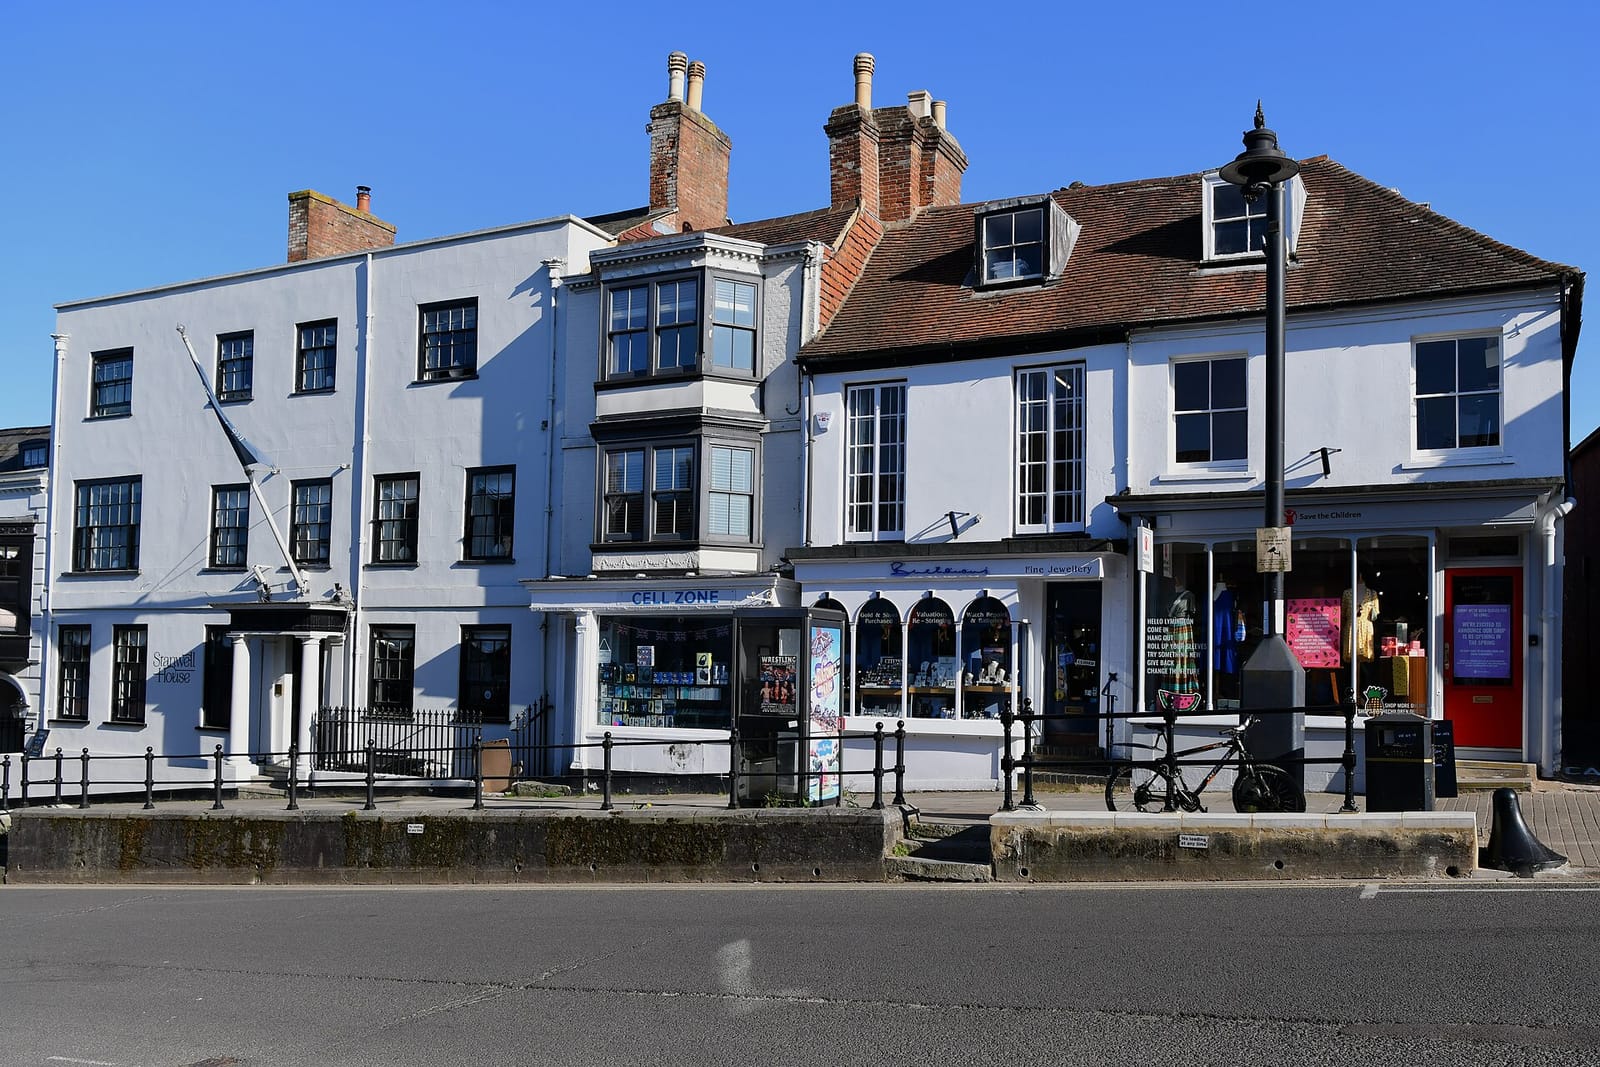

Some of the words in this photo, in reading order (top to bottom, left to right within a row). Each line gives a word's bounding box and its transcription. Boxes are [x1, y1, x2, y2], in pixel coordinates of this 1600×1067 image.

[1318, 512, 1330, 520] the
[1330, 511, 1362, 519] Children
[1025, 565, 1044, 574] Fine
[1047, 564, 1093, 575] Jewellery
[632, 591, 670, 605] CELL
[674, 590, 719, 604] ZONE
[152, 651, 196, 668] Stanwell
[153, 667, 191, 684] House
